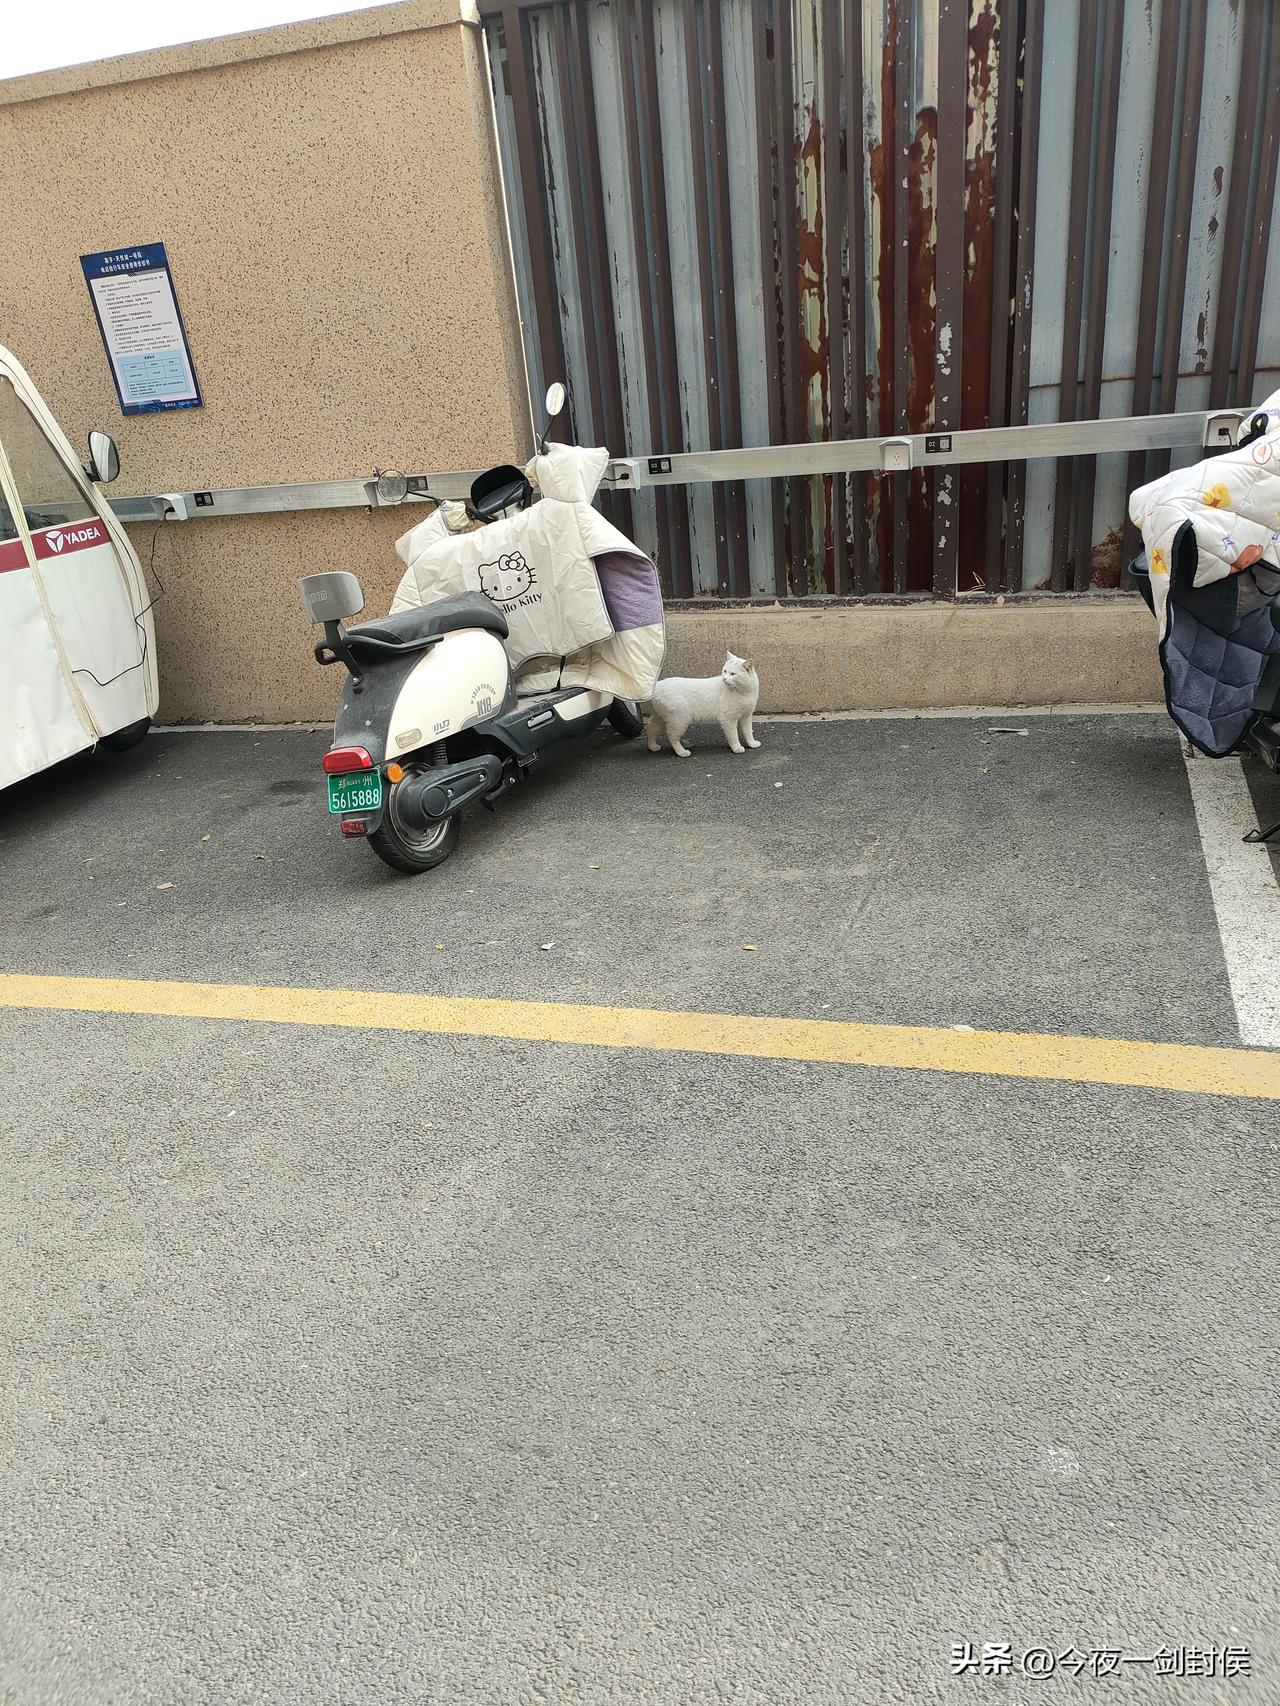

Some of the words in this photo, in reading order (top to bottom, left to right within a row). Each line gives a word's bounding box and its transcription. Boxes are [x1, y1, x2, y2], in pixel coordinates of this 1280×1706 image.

[64, 526, 101, 545] YADEA
[518, 592, 542, 608] Kitty
[332, 788, 379, 809] 5615888
